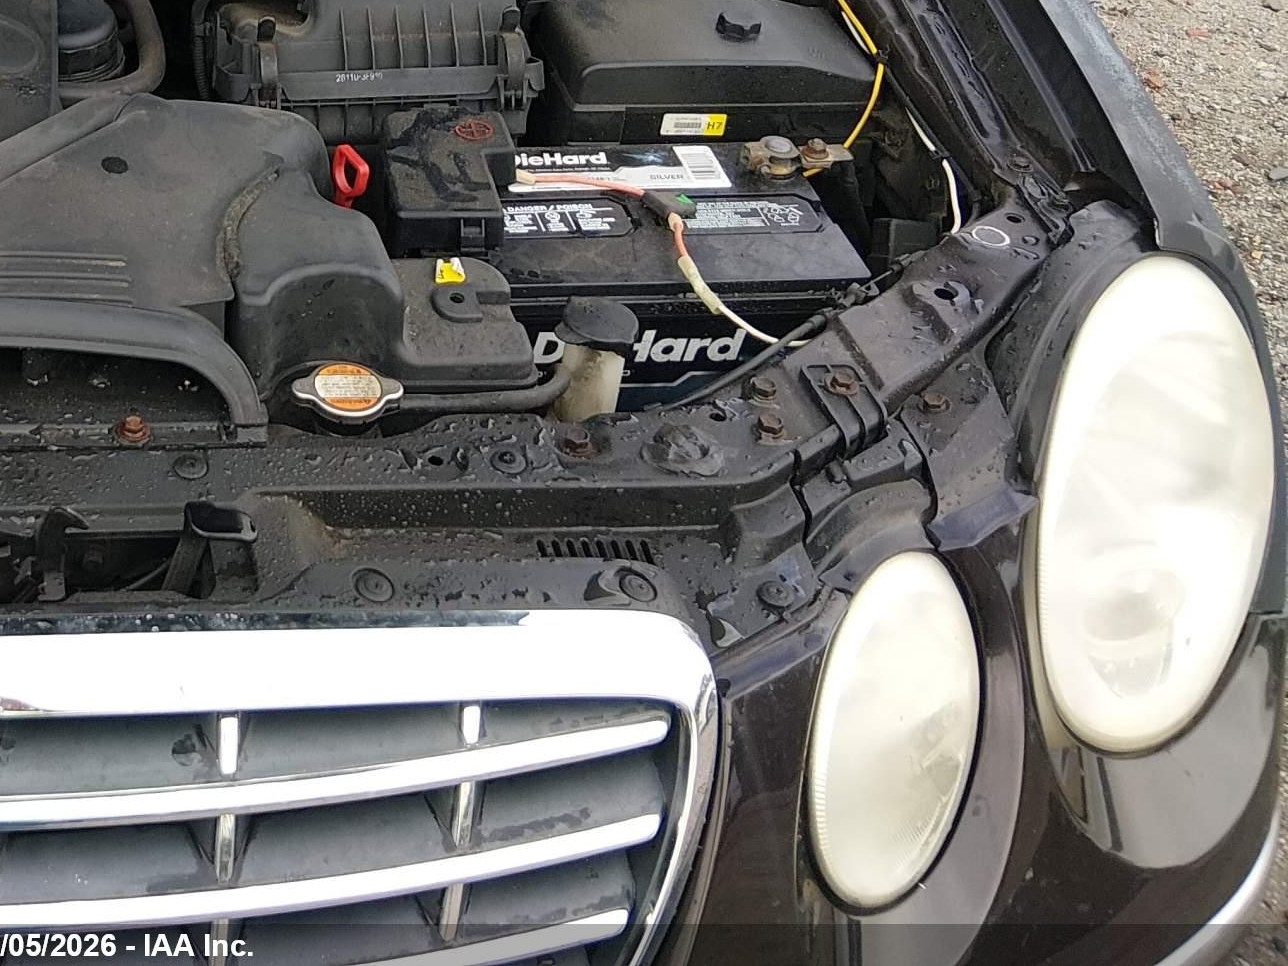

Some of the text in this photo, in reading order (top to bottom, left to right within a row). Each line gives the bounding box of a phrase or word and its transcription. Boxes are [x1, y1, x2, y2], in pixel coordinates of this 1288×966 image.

[706, 121, 723, 131] H7
[507, 205, 547, 213] DANGER
[556, 203, 593, 211] POISON
[533, 329, 746, 364] DHard
